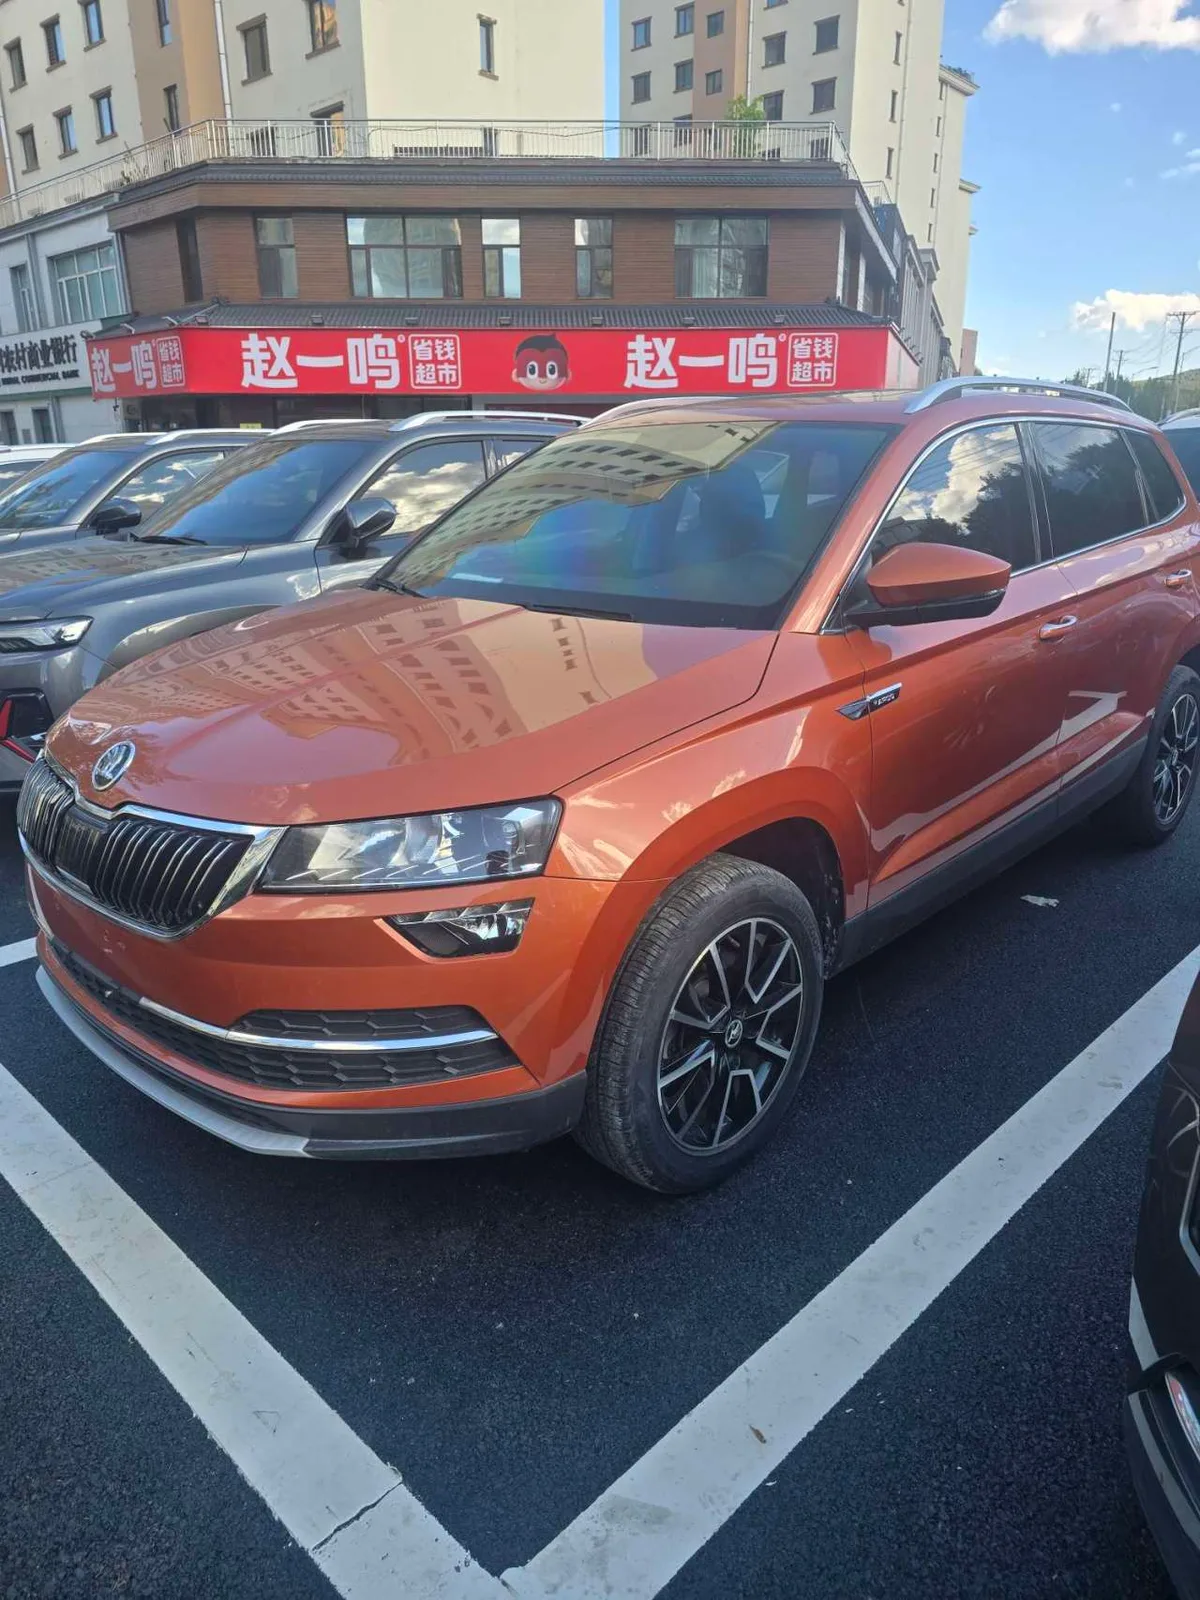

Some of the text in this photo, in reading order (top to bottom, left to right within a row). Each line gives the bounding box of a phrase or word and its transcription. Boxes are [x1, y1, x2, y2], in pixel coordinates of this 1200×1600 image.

[413, 339, 456, 361] 省钱
[793, 337, 833, 358] 省钱
[91, 340, 157, 392] 赵一鸣
[241, 333, 400, 389] 赵一鸣
[624, 333, 778, 389] 赵一鸣
[791, 361, 833, 382] 超市
[415, 362, 457, 384] 超市
